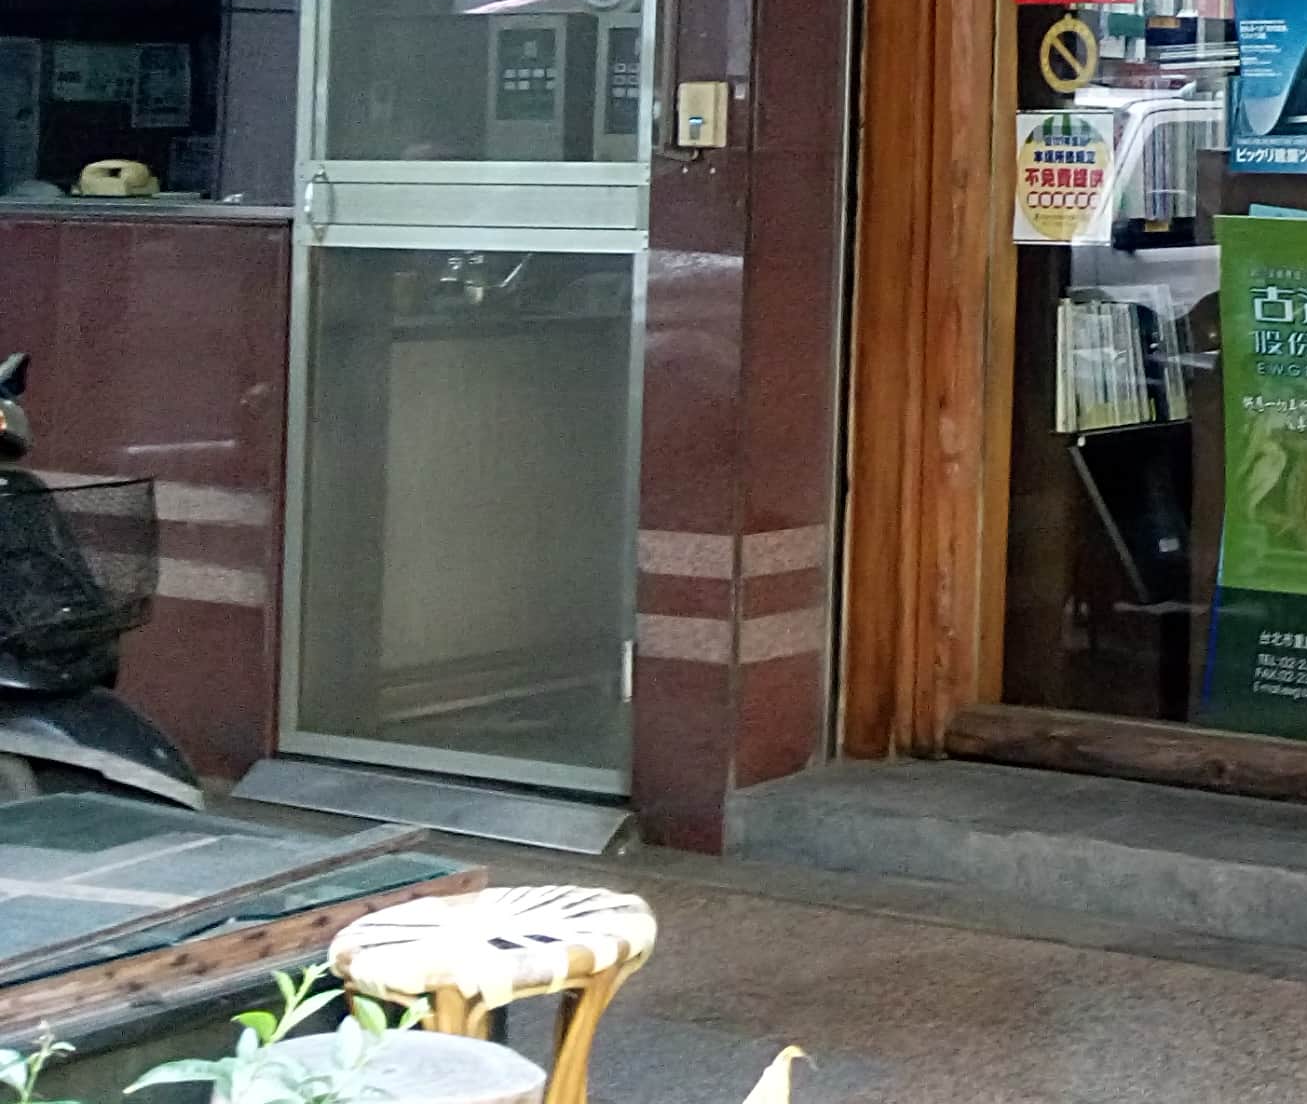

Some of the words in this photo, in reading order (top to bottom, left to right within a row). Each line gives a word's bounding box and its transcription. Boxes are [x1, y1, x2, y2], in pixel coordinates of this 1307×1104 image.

[1024, 167, 1104, 187] 不免費提供
